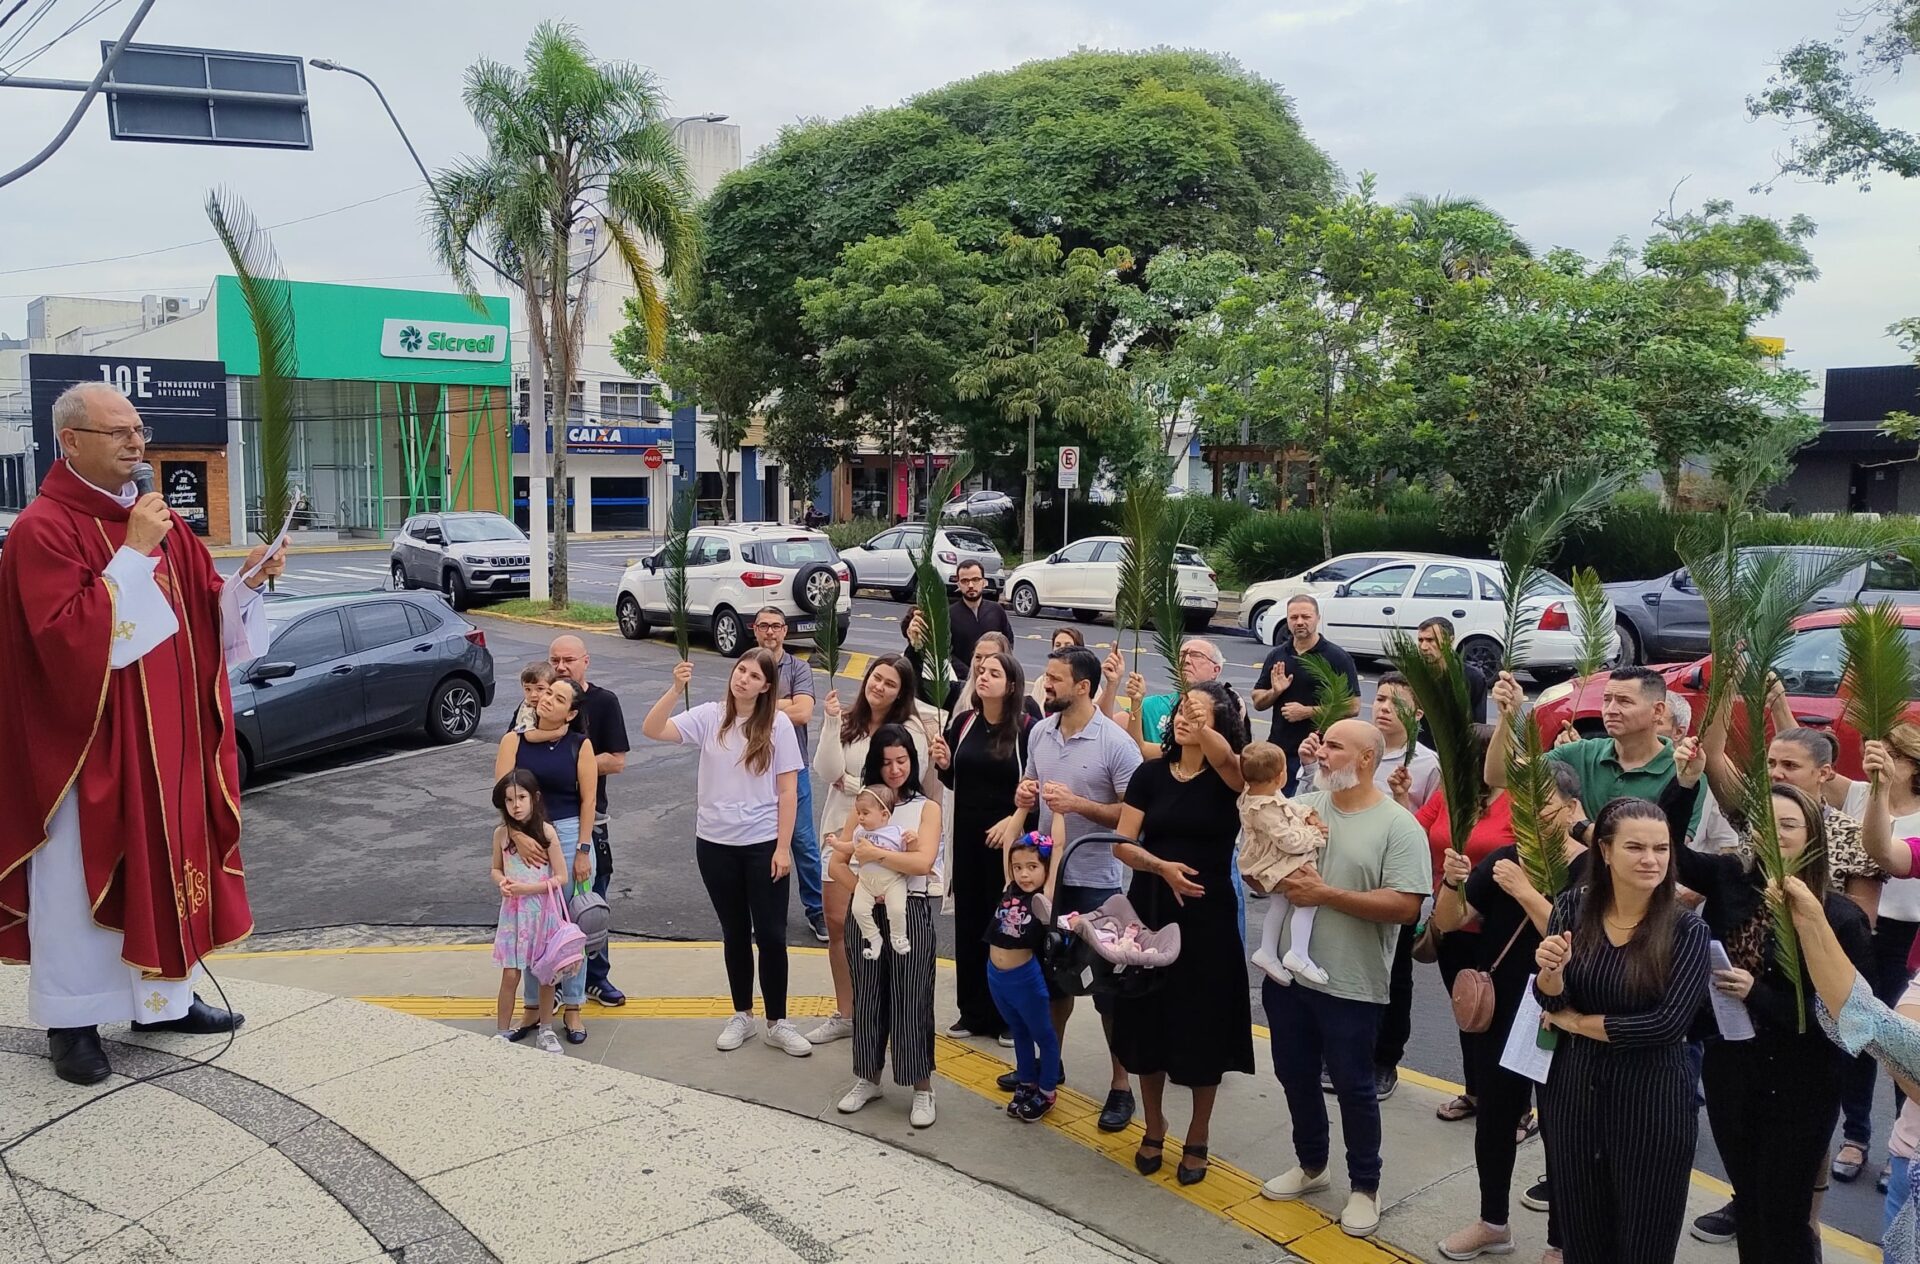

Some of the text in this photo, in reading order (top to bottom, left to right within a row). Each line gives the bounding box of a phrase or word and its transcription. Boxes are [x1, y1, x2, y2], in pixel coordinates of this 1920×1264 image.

[427, 332, 495, 353] Sicredi
[100, 364, 153, 398] JOE
[157, 389, 201, 398] ARTESANAL
[568, 428, 622, 442] CAIXA
[644, 454, 661, 462] PARE
